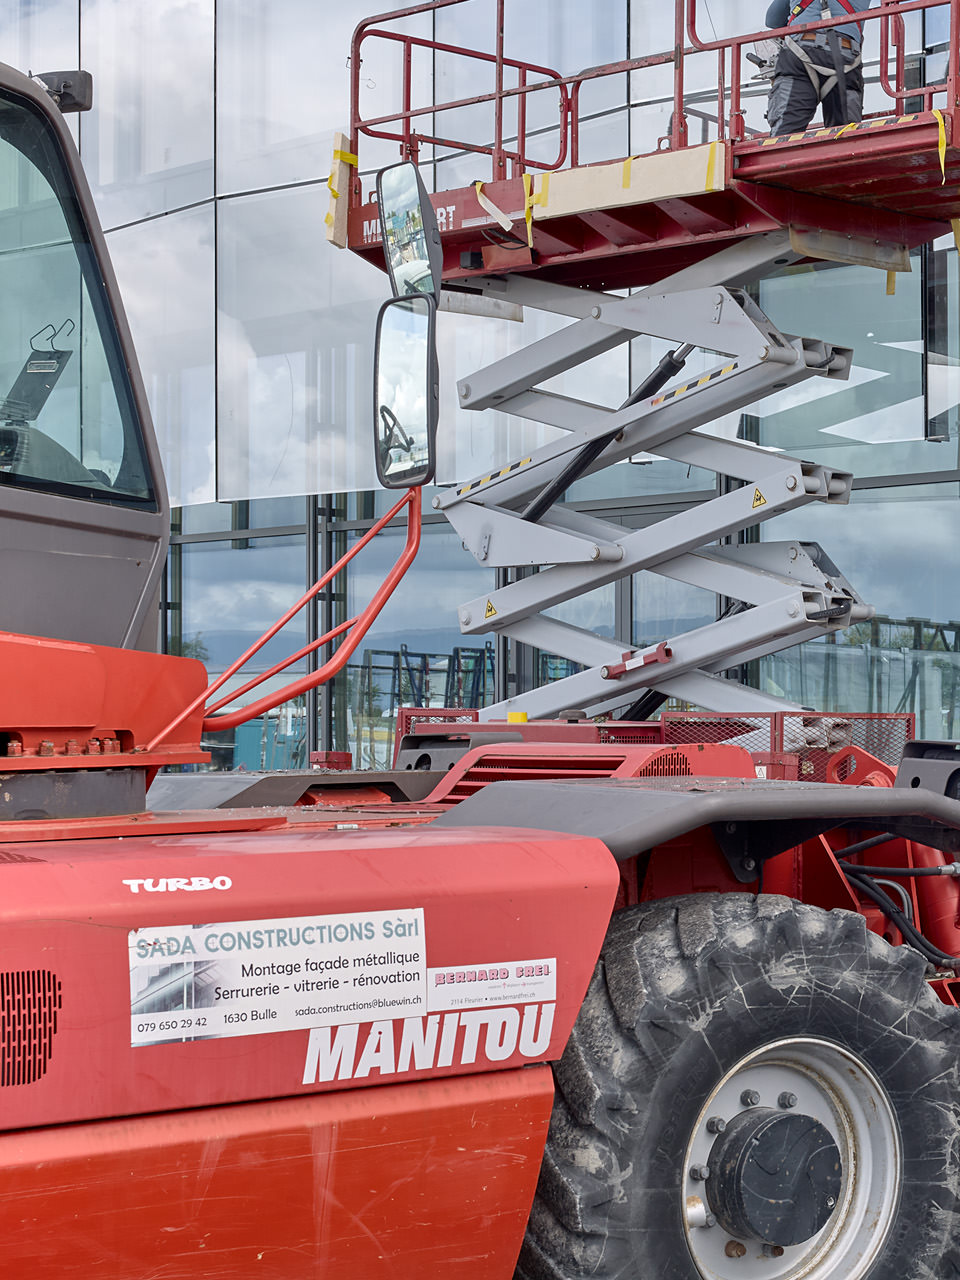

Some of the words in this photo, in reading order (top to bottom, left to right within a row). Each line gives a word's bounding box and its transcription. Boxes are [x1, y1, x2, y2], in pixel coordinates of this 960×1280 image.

[122, 876, 232, 893] TURBO
[136, 935, 196, 958] SADA
[204, 922, 375, 953] CONSTRUCTIONS
[383, 918, 419, 938] Sàrl
[241, 962, 301, 978] Montage
[305, 956, 349, 974] façade
[353, 951, 420, 970] métallique
[435, 968, 509, 987] BERNARD
[515, 964, 552, 978] FREI
[214, 984, 280, 1000] Serrurerie
[293, 979, 339, 994] vitrerie
[353, 970, 420, 987] rénovation
[137, 1022, 156, 1033] 079
[158, 1020, 178, 1031] 650
[180, 1018, 193, 1029] 29
[194, 1017, 208, 1028] 42
[223, 1012, 248, 1024] 1630
[251, 1008, 277, 1022] Bulle
[295, 996, 422, 1017] sada.constructions@bluewin.ch
[302, 1003, 556, 1085] MANITOU
